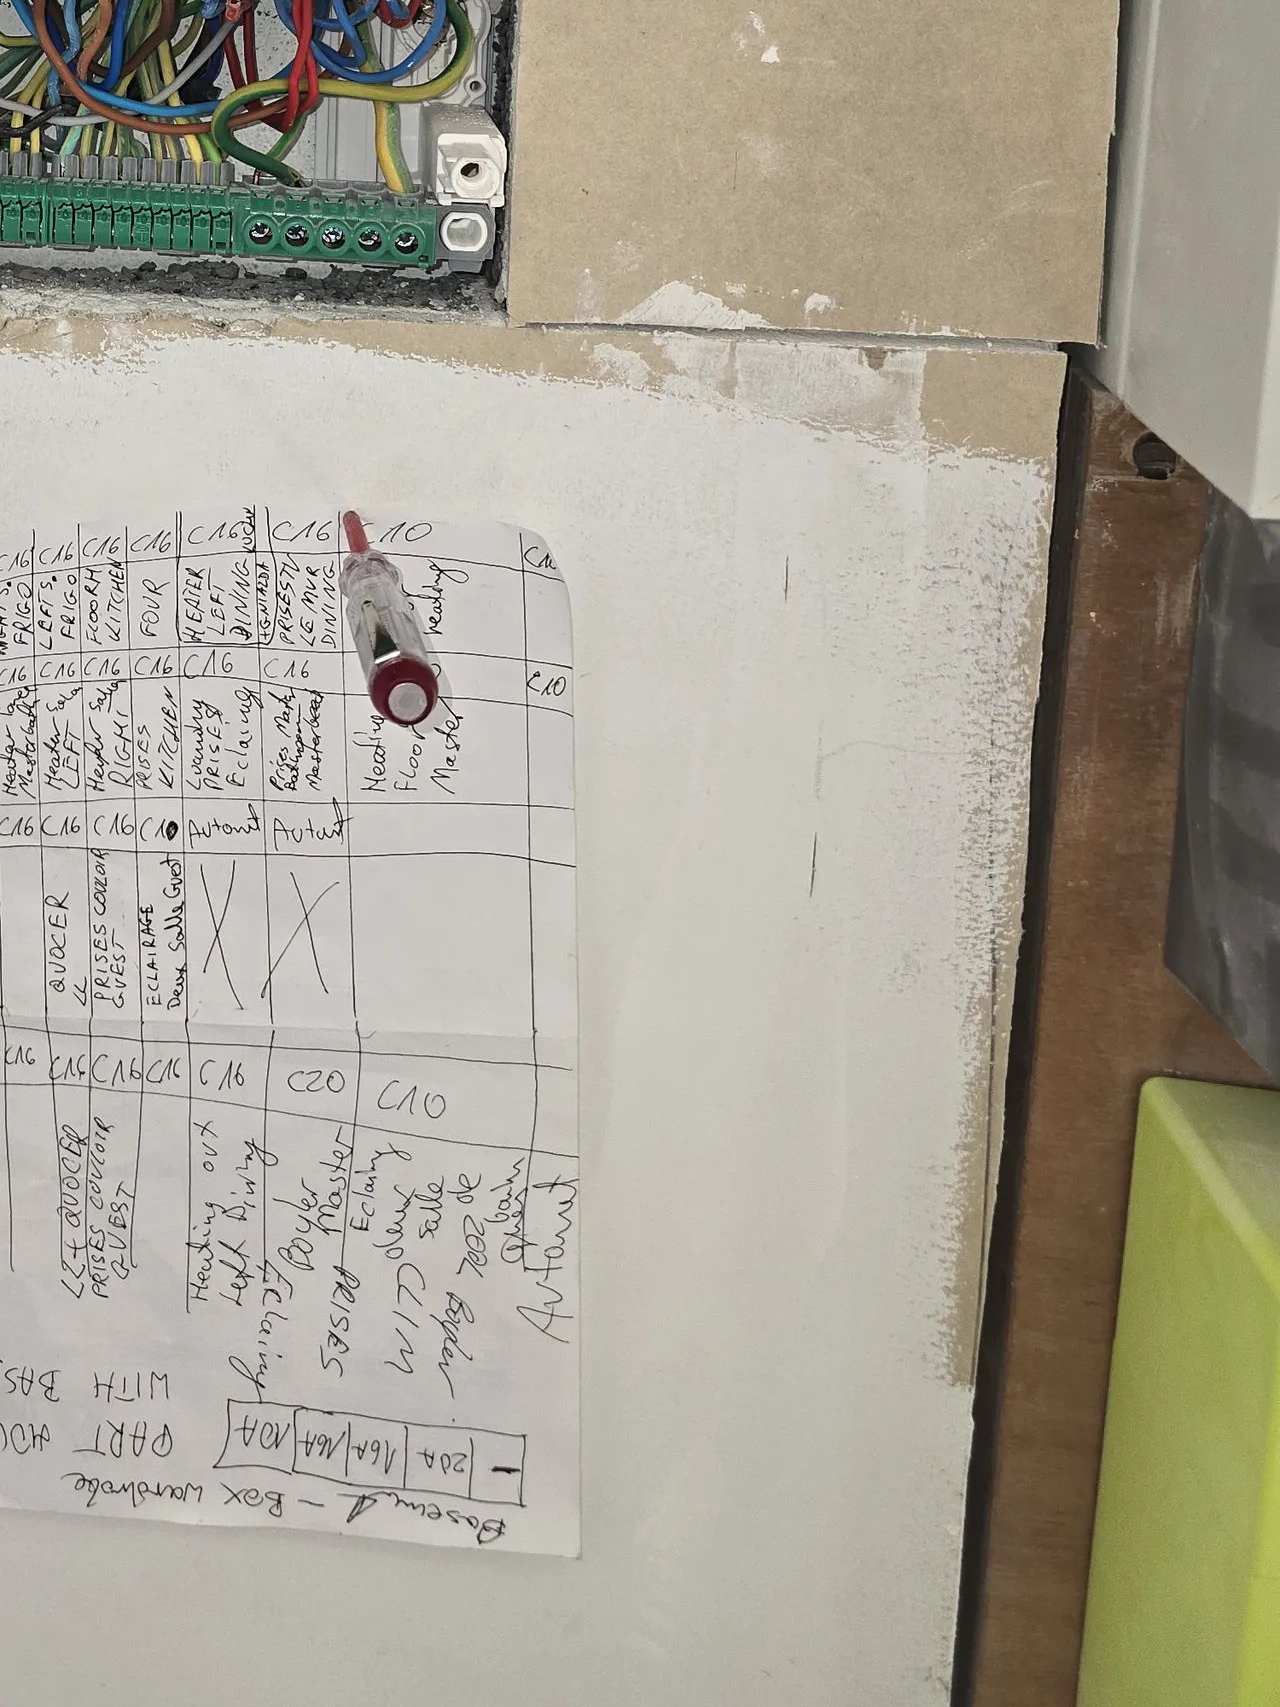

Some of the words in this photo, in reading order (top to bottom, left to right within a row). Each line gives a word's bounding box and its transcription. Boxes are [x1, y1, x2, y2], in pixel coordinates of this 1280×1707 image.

[82, 537, 121, 557] C16
[130, 530, 171, 553] C16
[187, 521, 240, 545] C16
[272, 520, 333, 542] C16
[39, 541, 73, 565] C16
[12, 582, 34, 645] FRIGO
[60, 574, 77, 639] FRIGO
[105, 557, 125, 641] KITCHEN
[140, 579, 170, 637] FOUR
[182, 567, 205, 641] HEATER
[207, 567, 225, 636] LEFT
[321, 561, 337, 648] DINING
[40, 662, 75, 679] C16
[84, 658, 120, 676] C16
[134, 655, 172, 675] C16
[263, 658, 309, 678] C16
[60, 719, 80, 789] LEFT
[158, 685, 180, 789] KITCHEN
[137, 725, 153, 790] PRISES
[41, 815, 80, 836] C16
[94, 813, 134, 836] C16
[93, 924, 111, 1001] PRISES
[140, 904, 162, 1006] ECLAIRAGE
[288, 1071, 344, 1093] C20
[377, 1080, 446, 1119] C10
[272, 1177, 314, 1271] Boyler
[89, 1225, 108, 1298] PRISES
[93, 1371, 170, 1403] WITH
[72, 1420, 172, 1459] PART
[234, 1415, 289, 1448] 10A
[297, 1430, 346, 1460] 16A
[352, 1440, 395, 1474] 16A
[416, 1448, 468, 1473] 20A
[220, 1482, 284, 1517] Box
